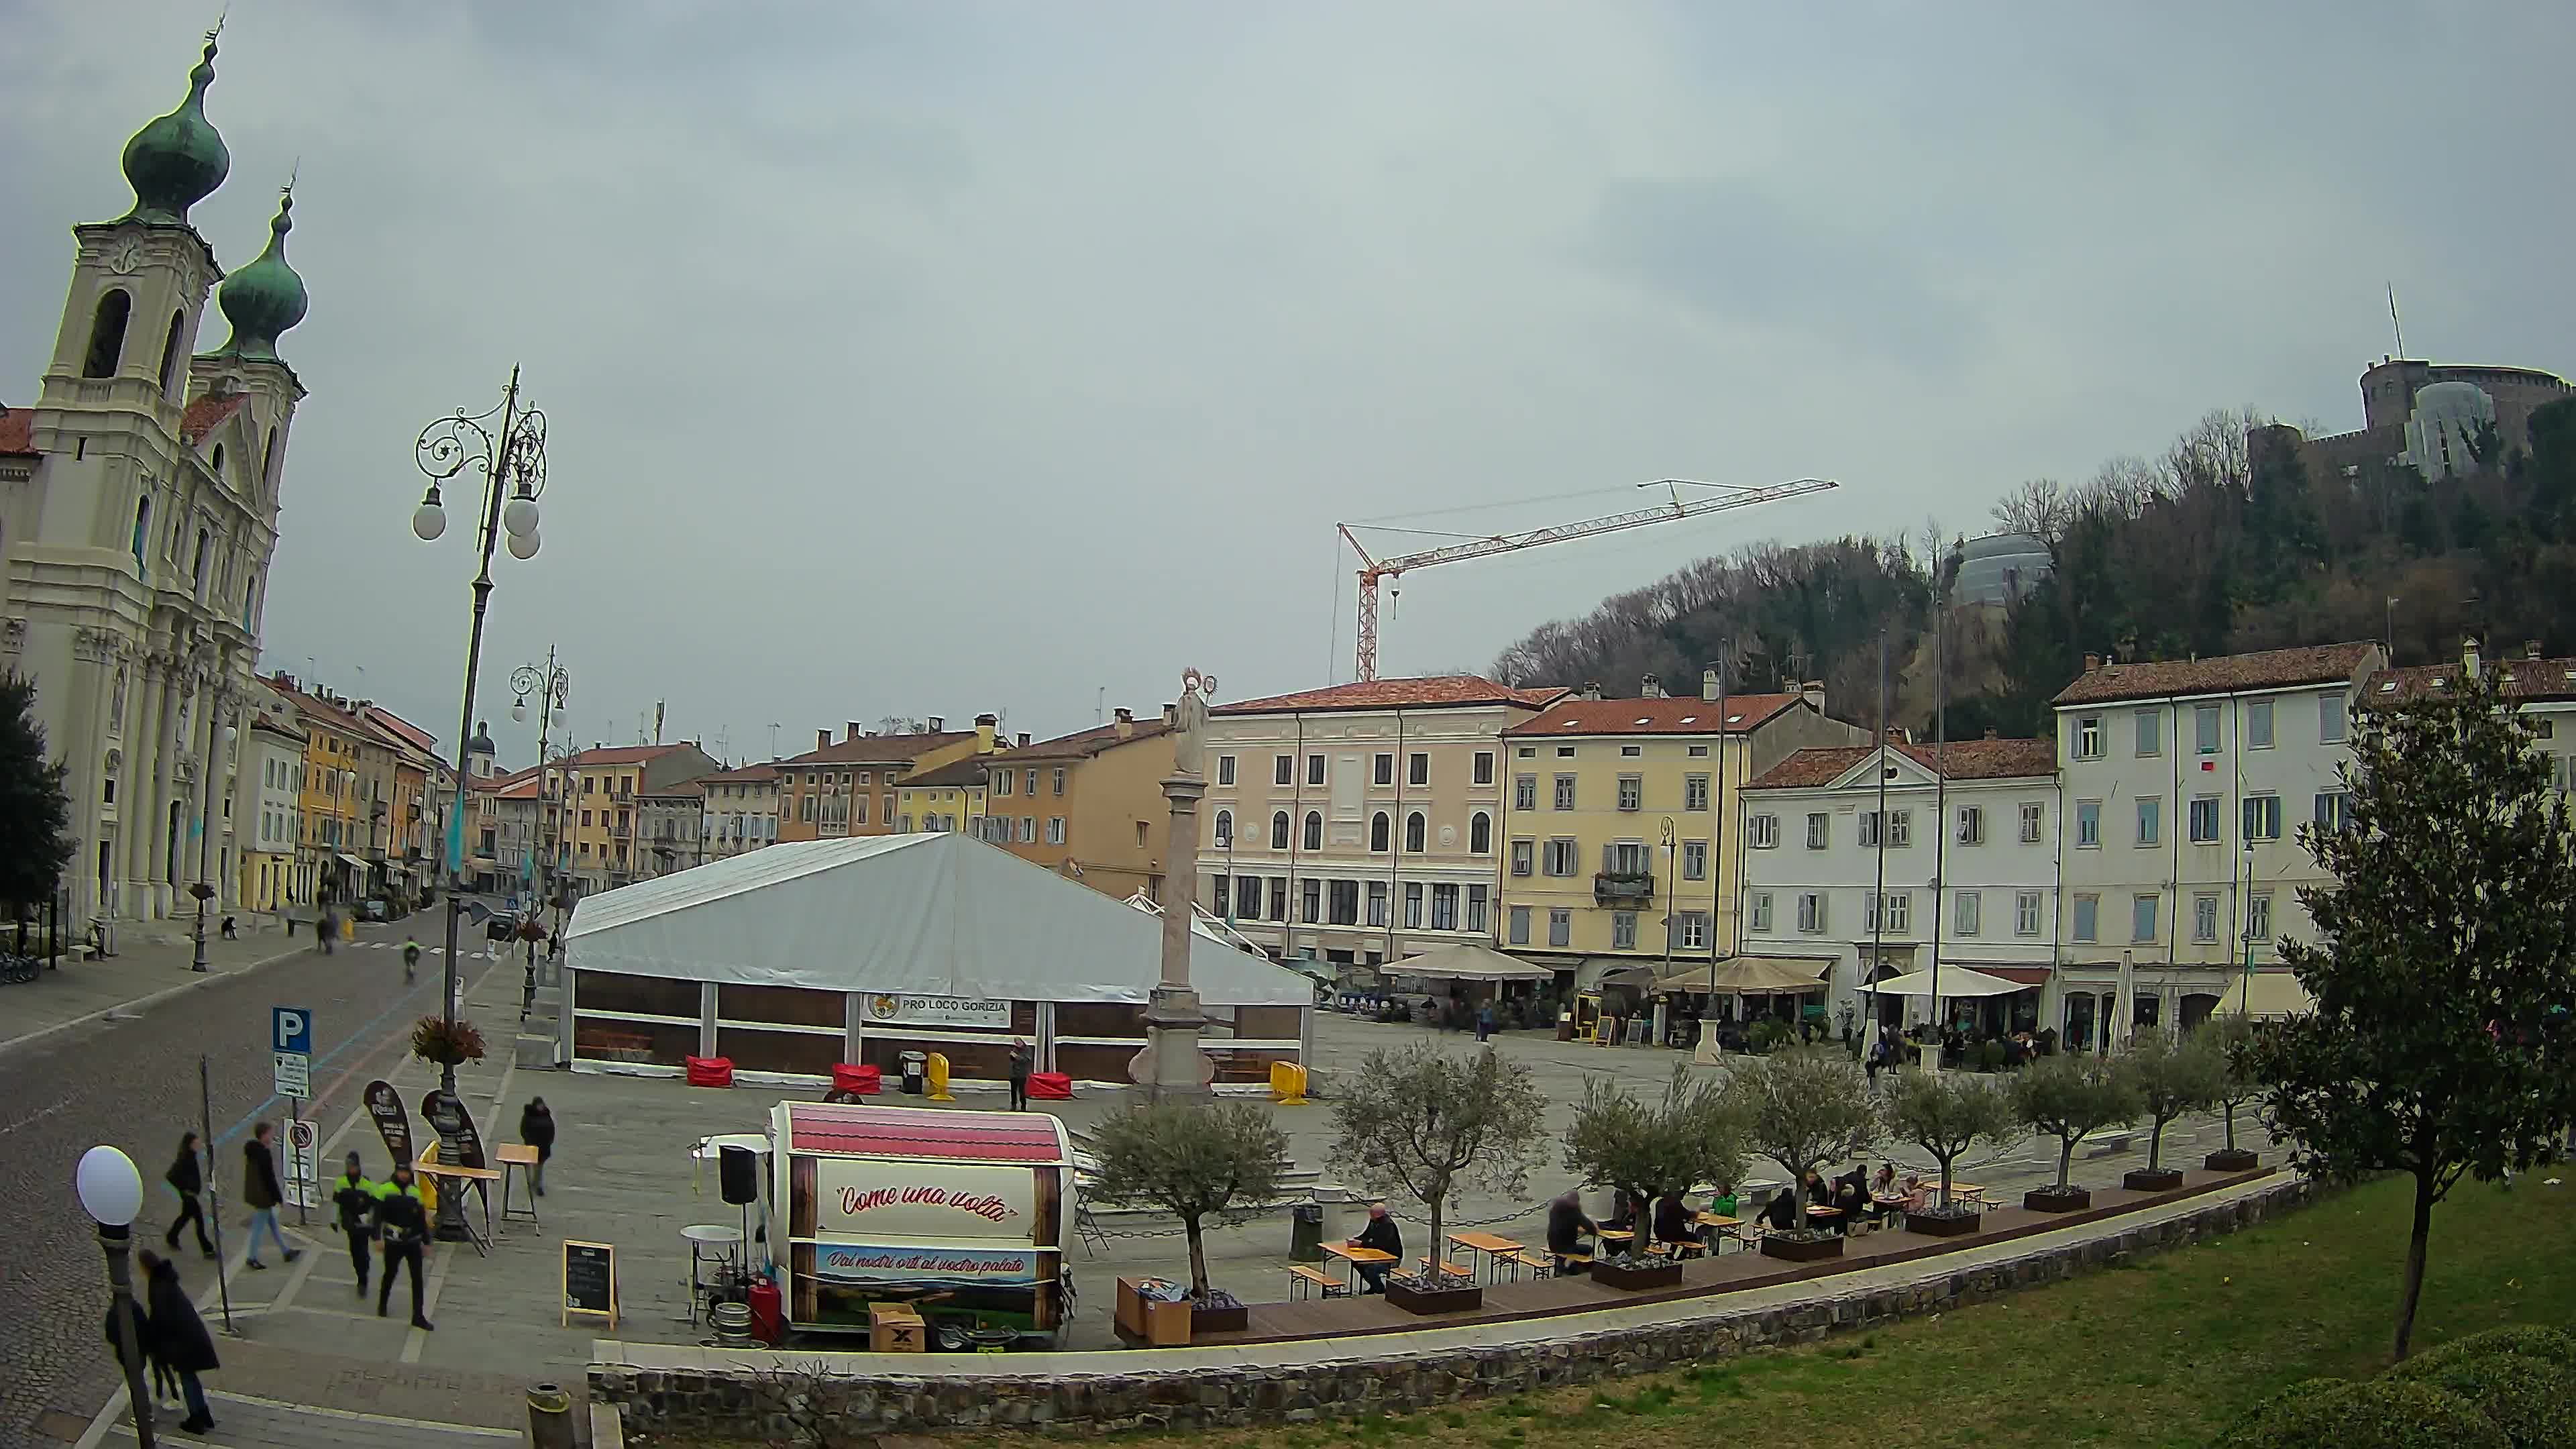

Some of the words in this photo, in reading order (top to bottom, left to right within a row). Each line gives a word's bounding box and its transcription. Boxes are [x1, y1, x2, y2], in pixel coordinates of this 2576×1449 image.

[903, 1000, 926, 1010] PRO
[929, 1000, 959, 1011] LOCO
[961, 1002, 1006, 1012] GORIZIA
[280, 1010, 303, 1047] P
[901, 1186, 946, 1205] una
[827, 1250, 858, 1267] Dai
[855, 1253, 896, 1269] nostri
[921, 1255, 938, 1269] al
[938, 1258, 979, 1272] vostro
[977, 1256, 1024, 1277] palato
